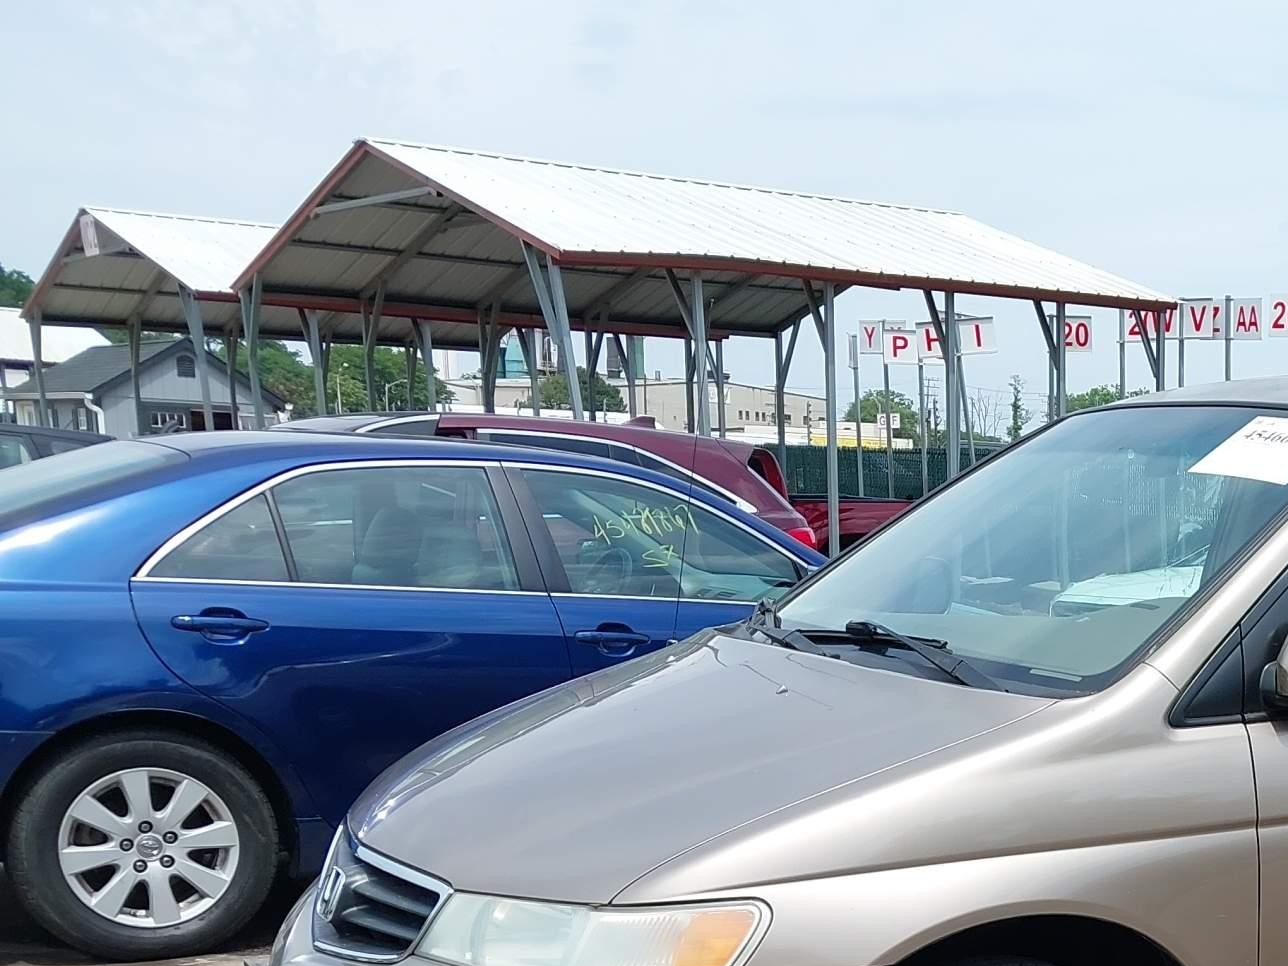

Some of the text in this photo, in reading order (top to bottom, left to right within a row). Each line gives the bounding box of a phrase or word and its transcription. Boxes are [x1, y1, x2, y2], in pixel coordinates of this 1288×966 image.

[1190, 305, 1207, 332] V
[1236, 305, 1259, 333] AA
[864, 326, 876, 348] Y
[892, 335, 908, 358] P
